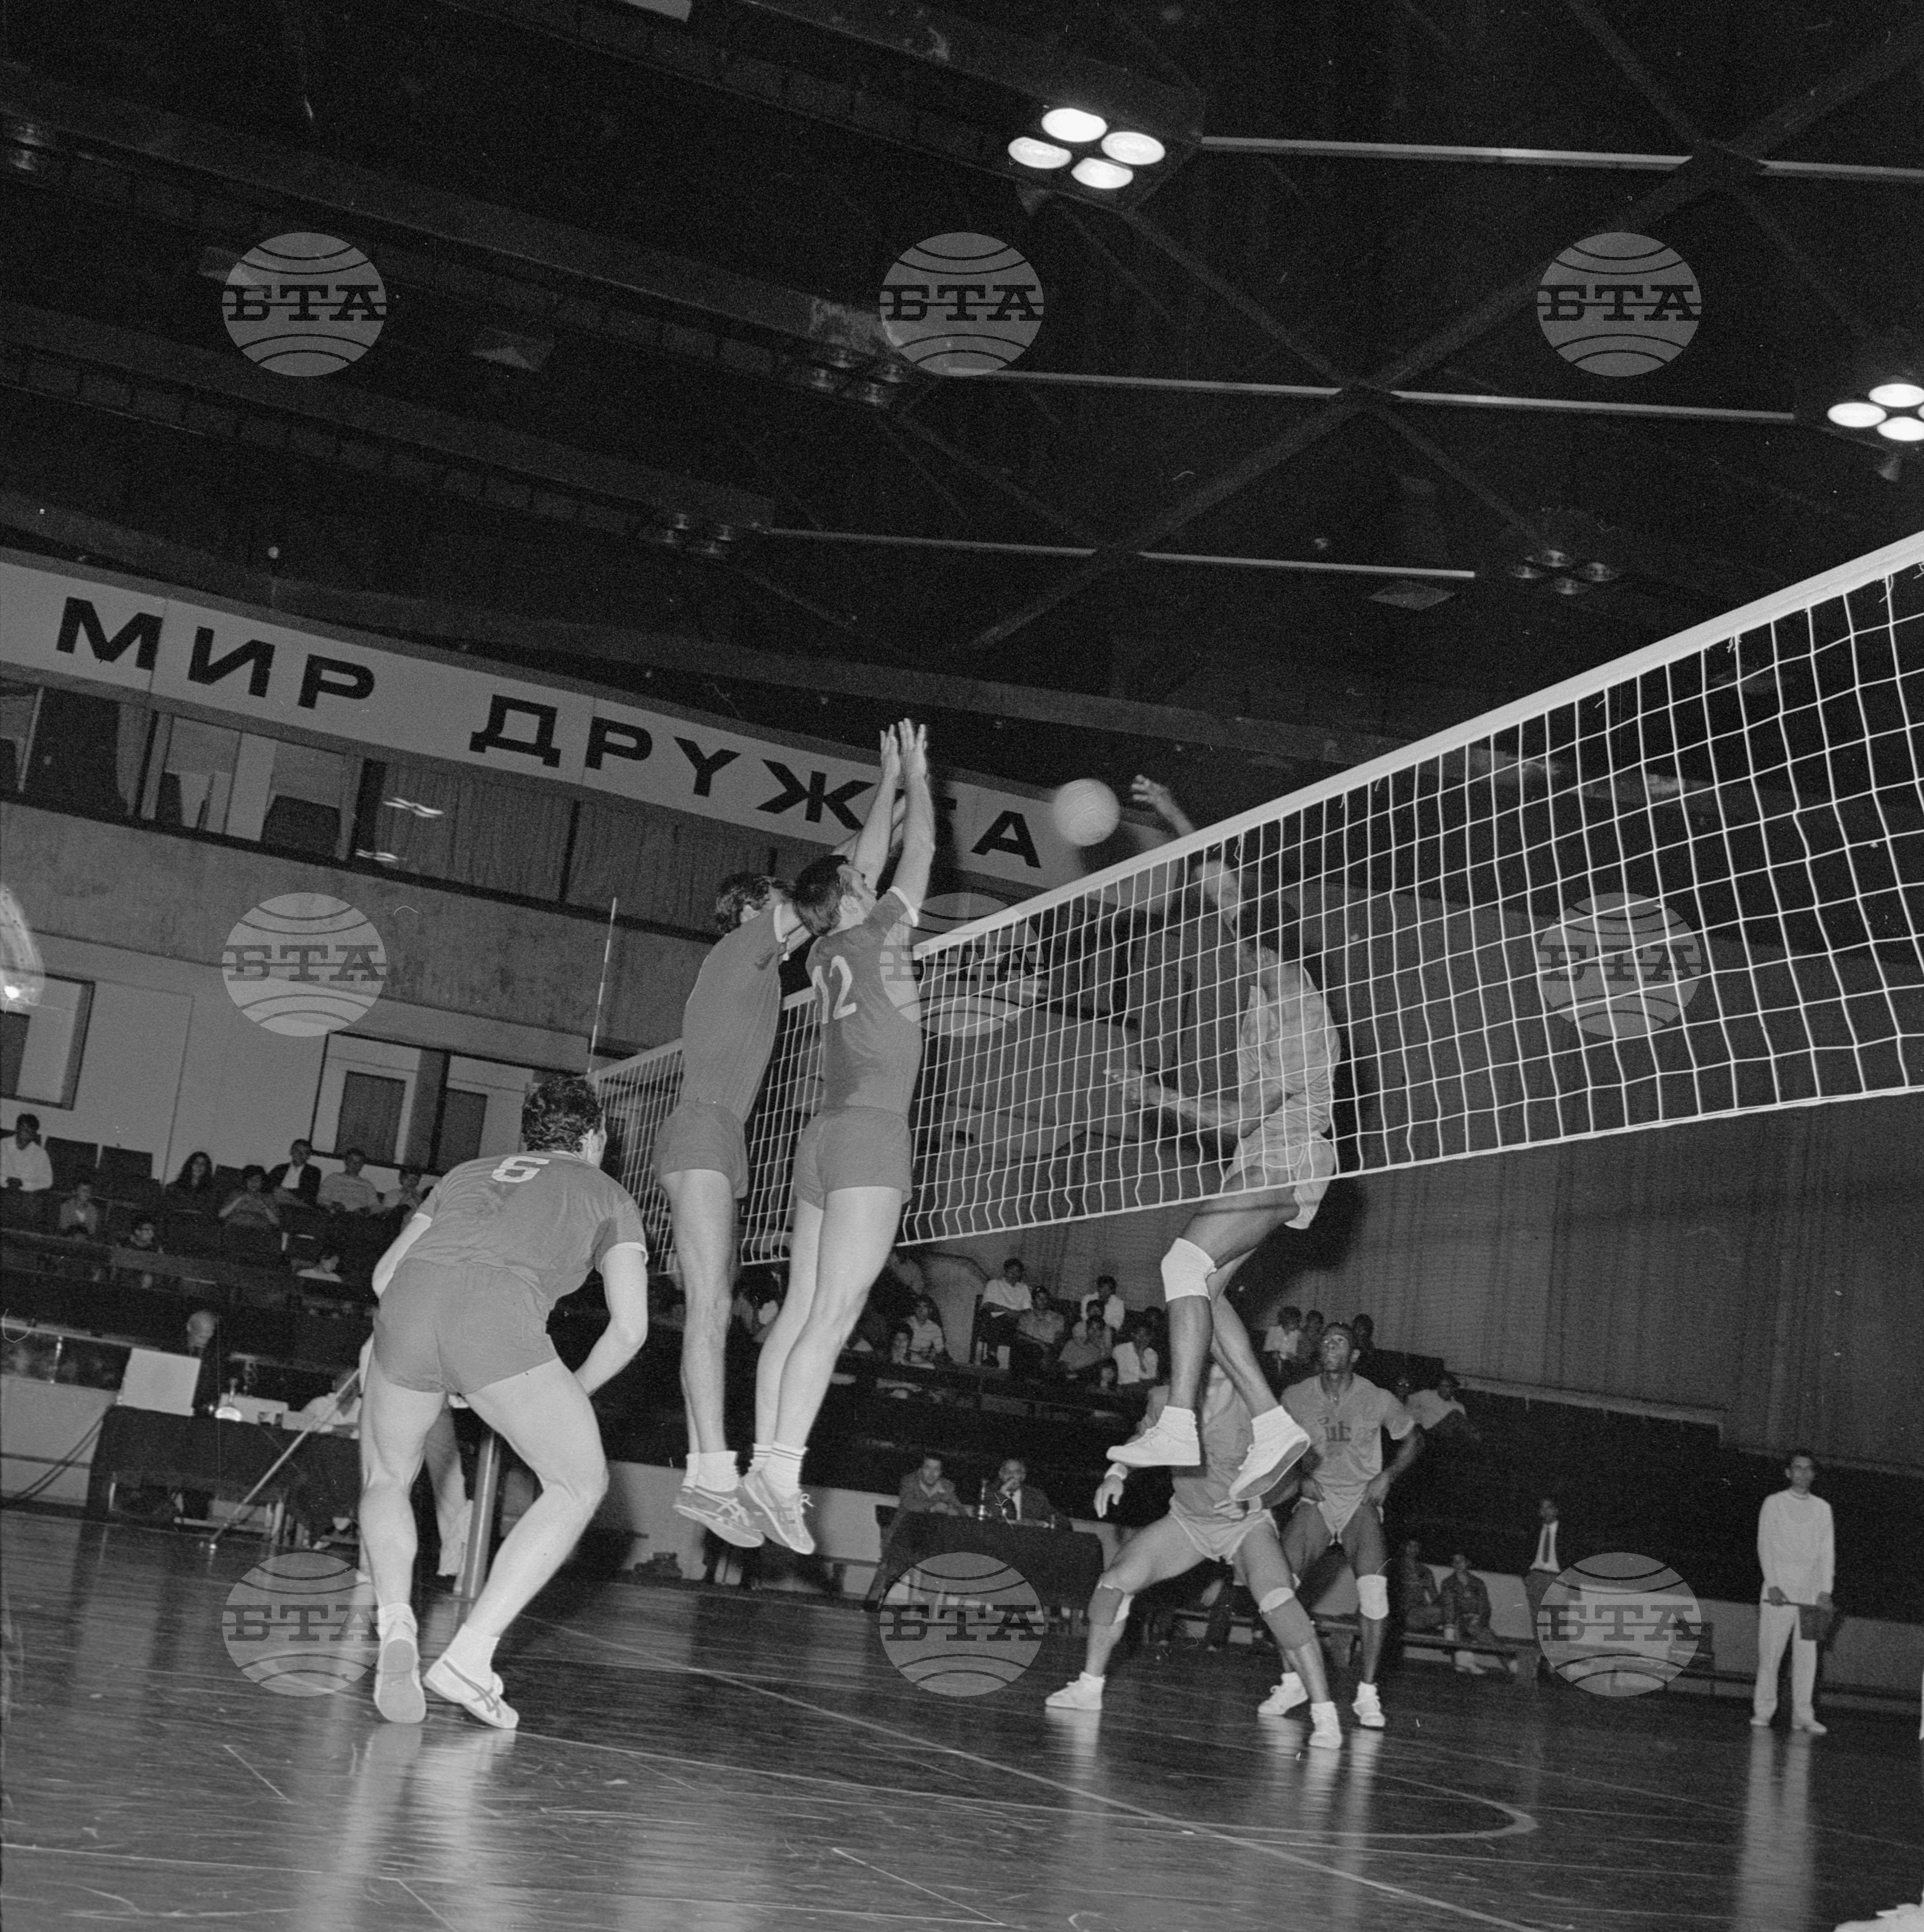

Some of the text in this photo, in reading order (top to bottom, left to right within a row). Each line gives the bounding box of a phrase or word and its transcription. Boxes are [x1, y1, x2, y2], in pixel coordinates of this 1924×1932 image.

[57, 597, 1041, 868] МИР ДРУЖА
[812, 955, 857, 1024] 12
[491, 1155, 550, 1183] 6
